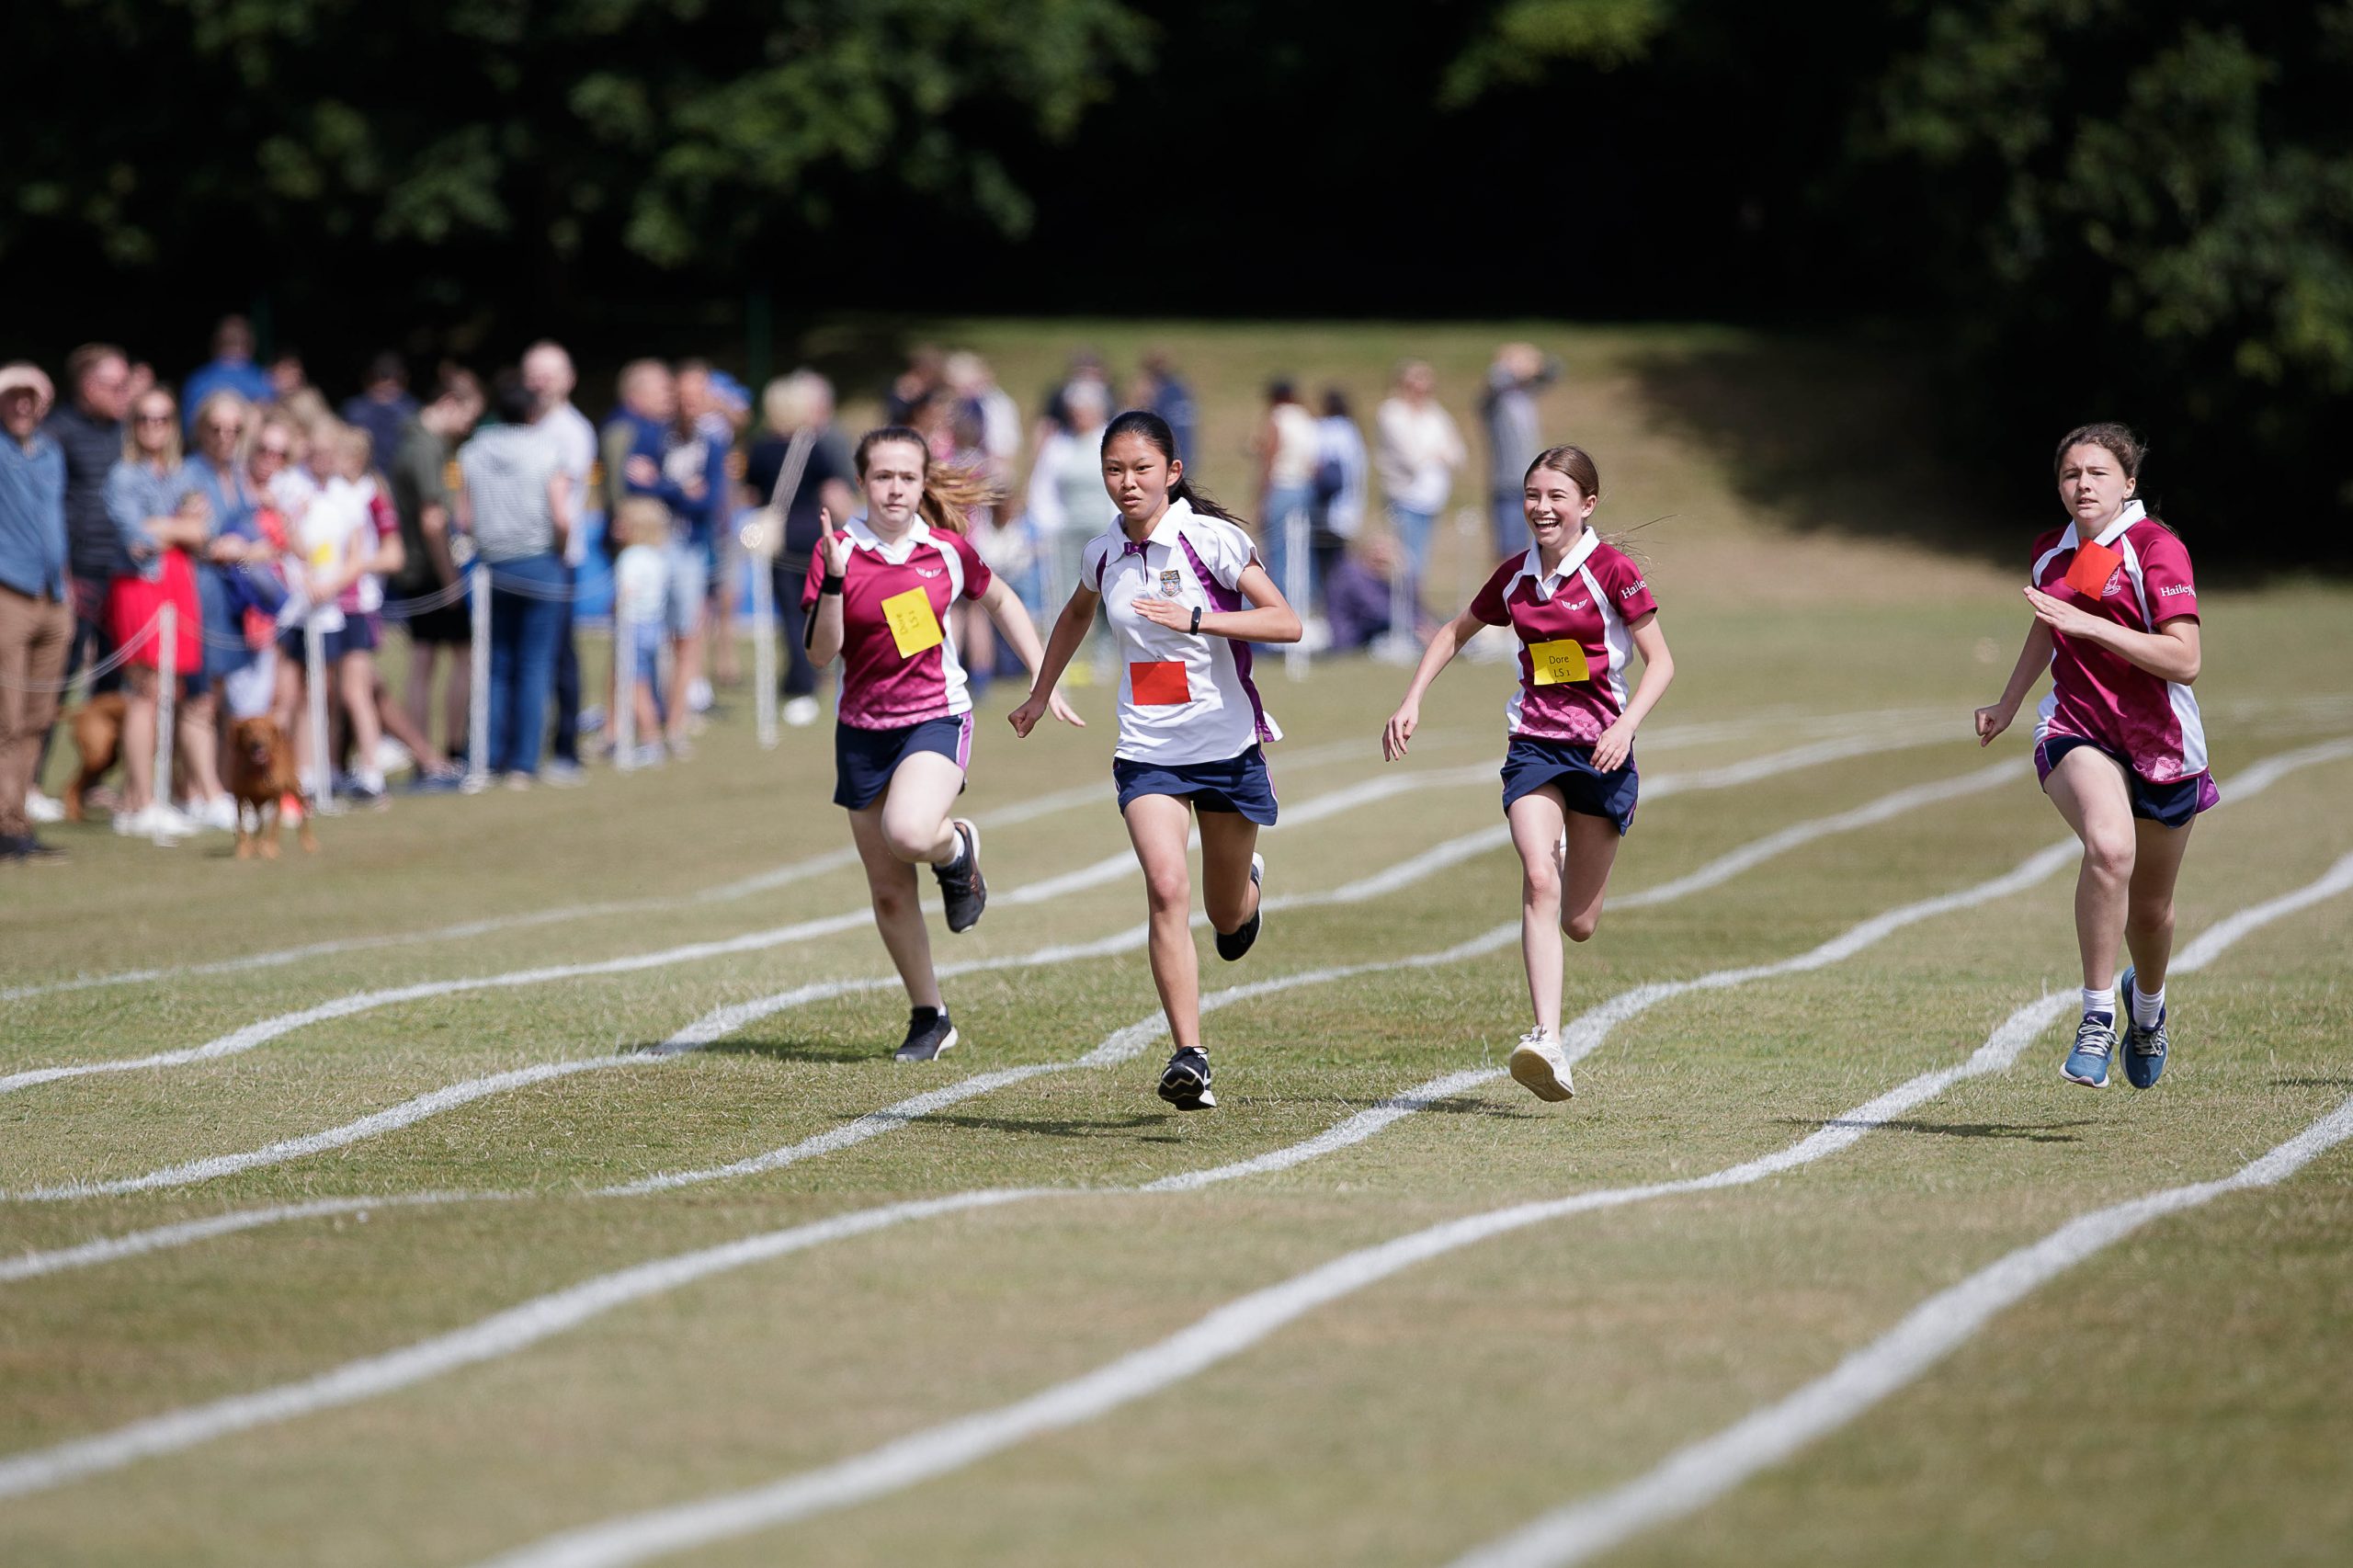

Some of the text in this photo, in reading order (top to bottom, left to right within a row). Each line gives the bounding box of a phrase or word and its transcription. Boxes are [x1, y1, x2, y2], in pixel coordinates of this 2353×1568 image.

[1621, 580, 1647, 599] Haile
[1549, 655, 1570, 665] Dore
[1553, 667, 1564, 677] LS
